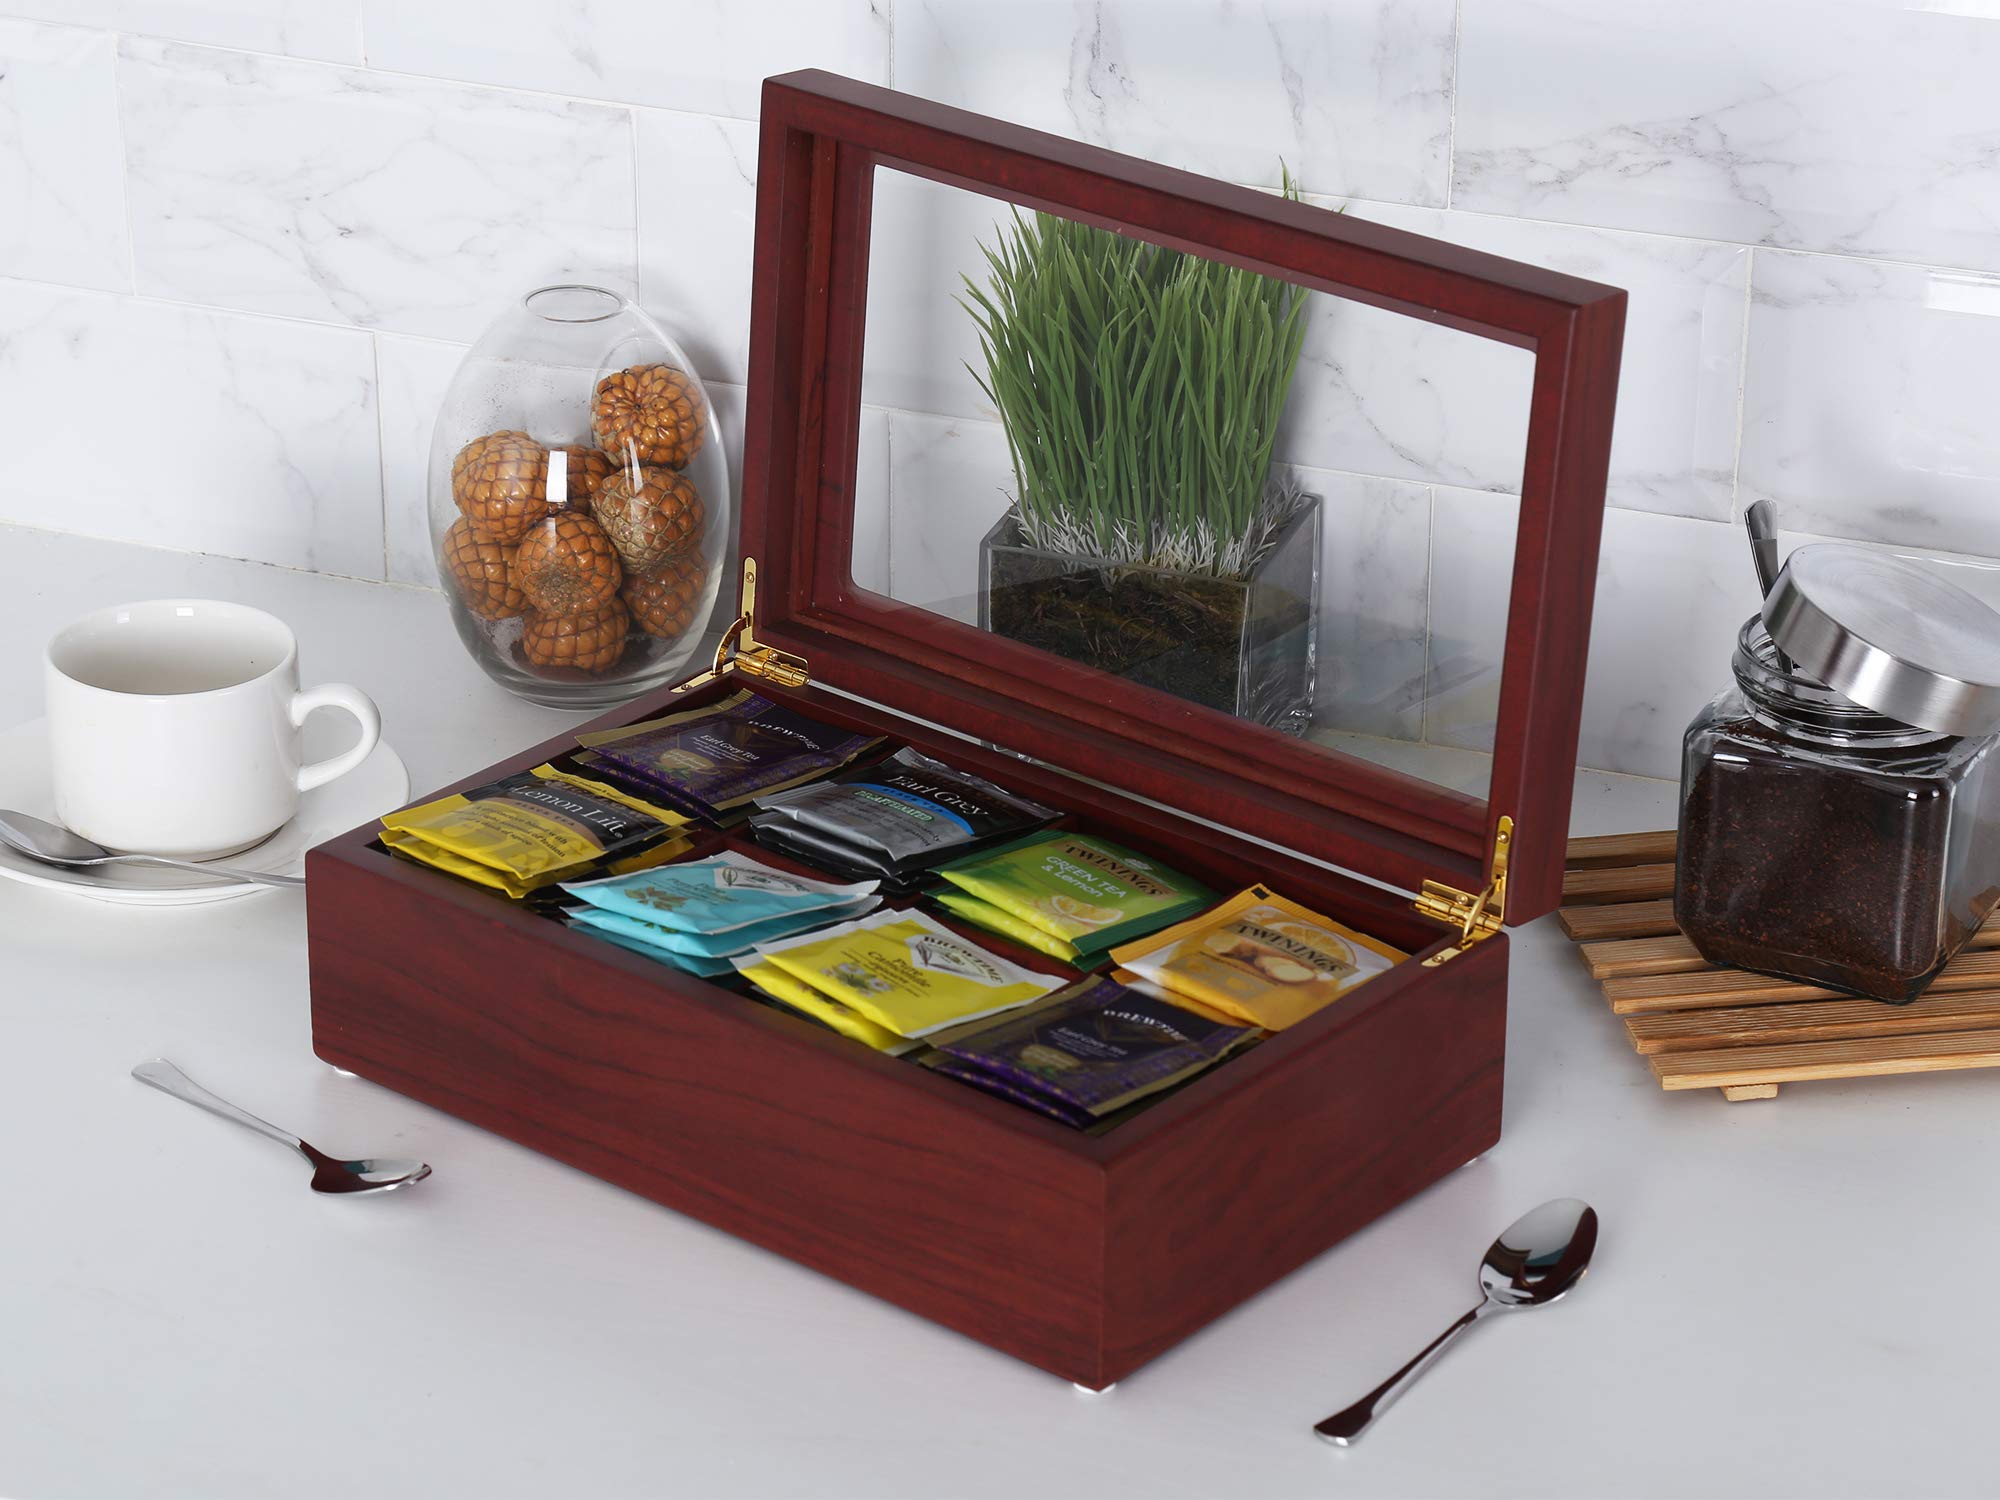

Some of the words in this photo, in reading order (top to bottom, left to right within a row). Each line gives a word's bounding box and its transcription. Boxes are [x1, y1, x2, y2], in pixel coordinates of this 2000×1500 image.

[700, 735, 722, 746] Earl
[510, 785, 583, 814] Lemon
[886, 776, 938, 794] Earl
[933, 791, 989, 815] Grey
[1041, 864, 1054, 872] &
[1054, 871, 1104, 898] Lemon
[1046, 856, 1098, 882] GREEN
[1098, 881, 1128, 898] TEA
[1065, 844, 1164, 896] TWININGS
[1237, 924, 1344, 973] TWININGS
